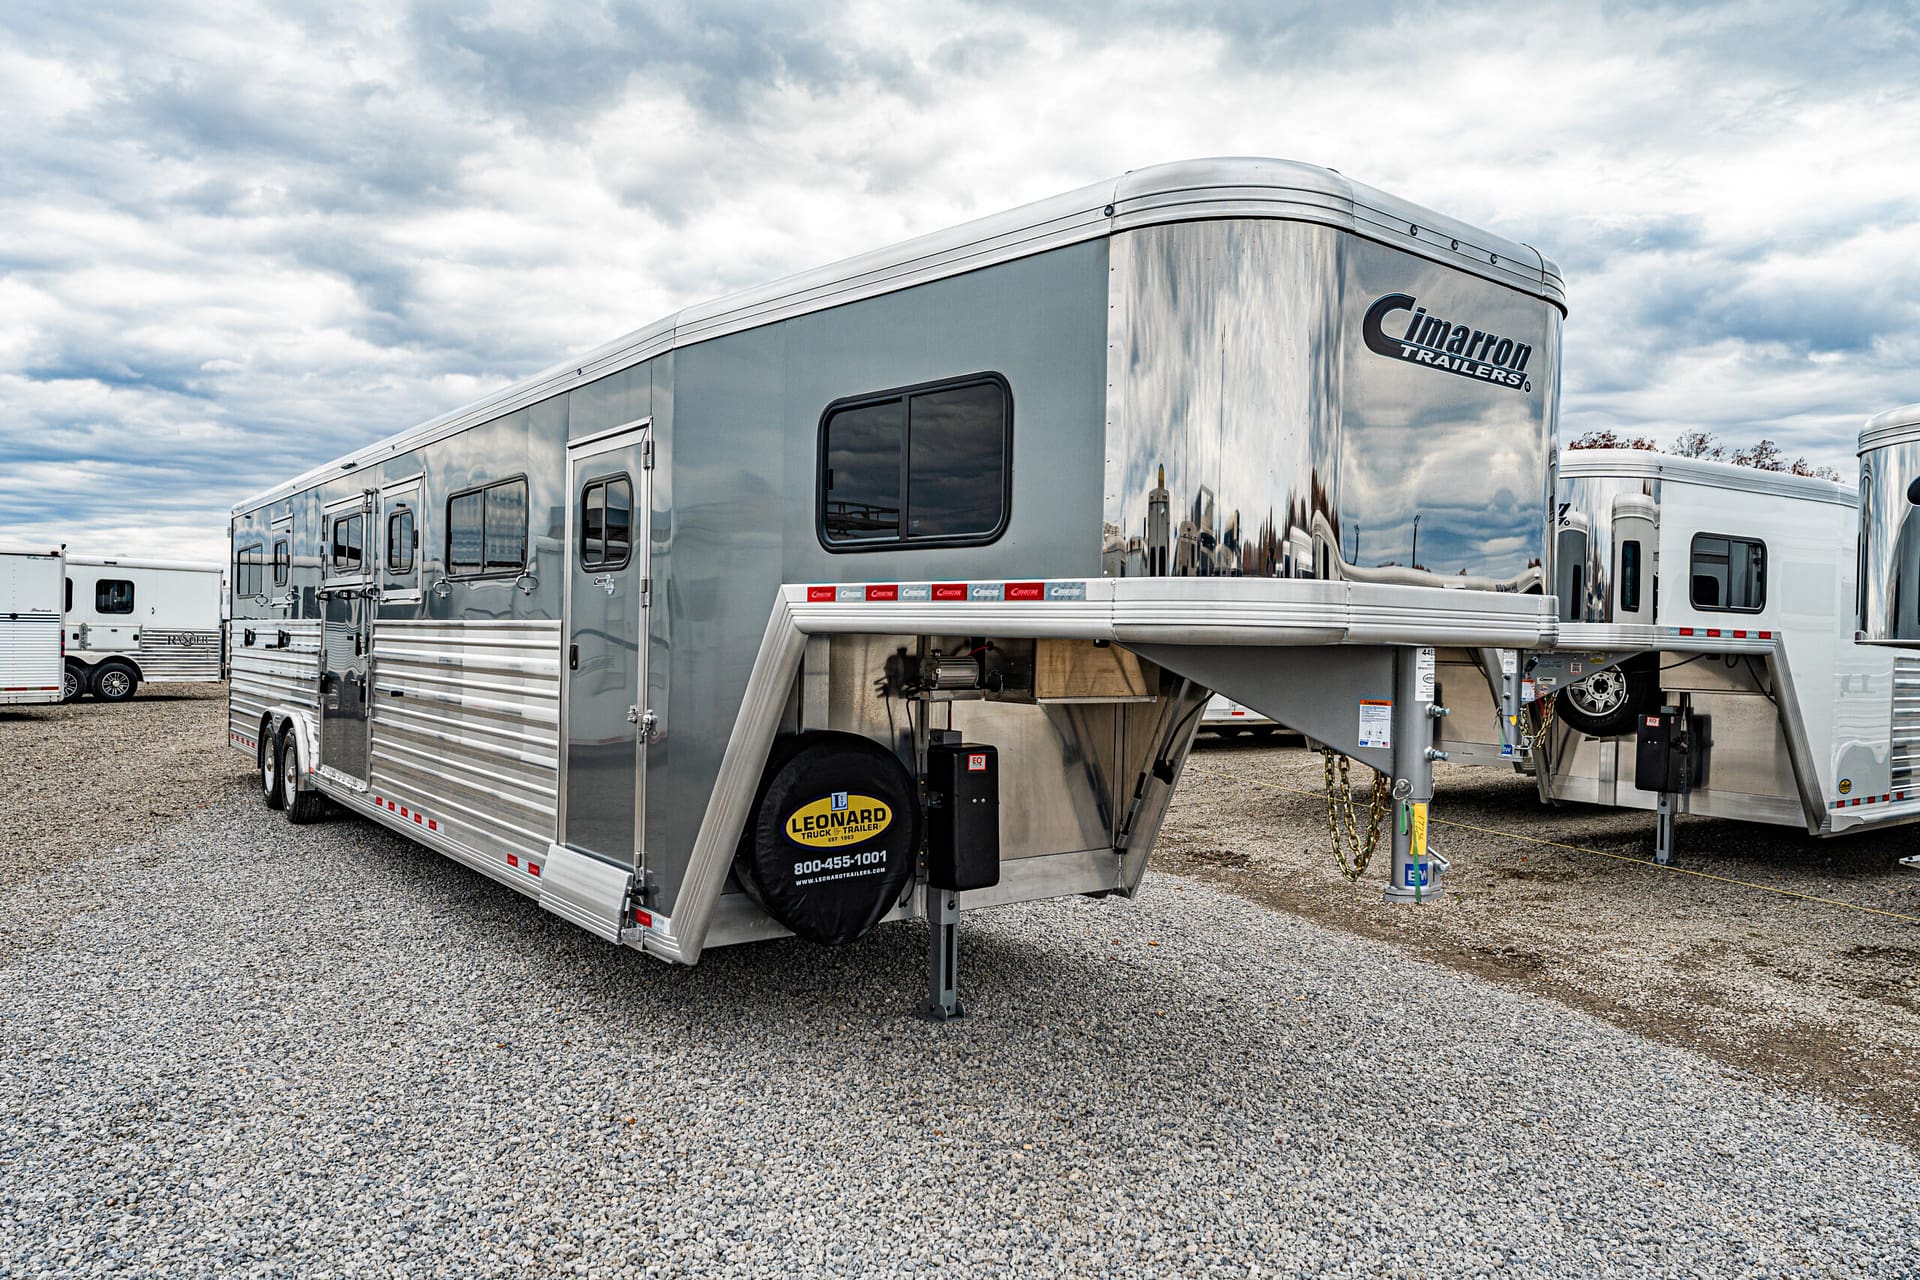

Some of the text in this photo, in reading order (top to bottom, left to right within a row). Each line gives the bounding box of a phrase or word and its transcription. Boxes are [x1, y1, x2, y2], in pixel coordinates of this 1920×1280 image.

[1363, 292, 1532, 372] Cimarron
[1400, 344, 1522, 386] TRAILERS
[972, 757, 982, 766] EQ
[792, 808, 886, 833] LEONARD
[801, 829, 831, 840] TRUCK
[842, 823, 879, 834] TRAILER
[794, 850, 887, 875] 800-455-1001
